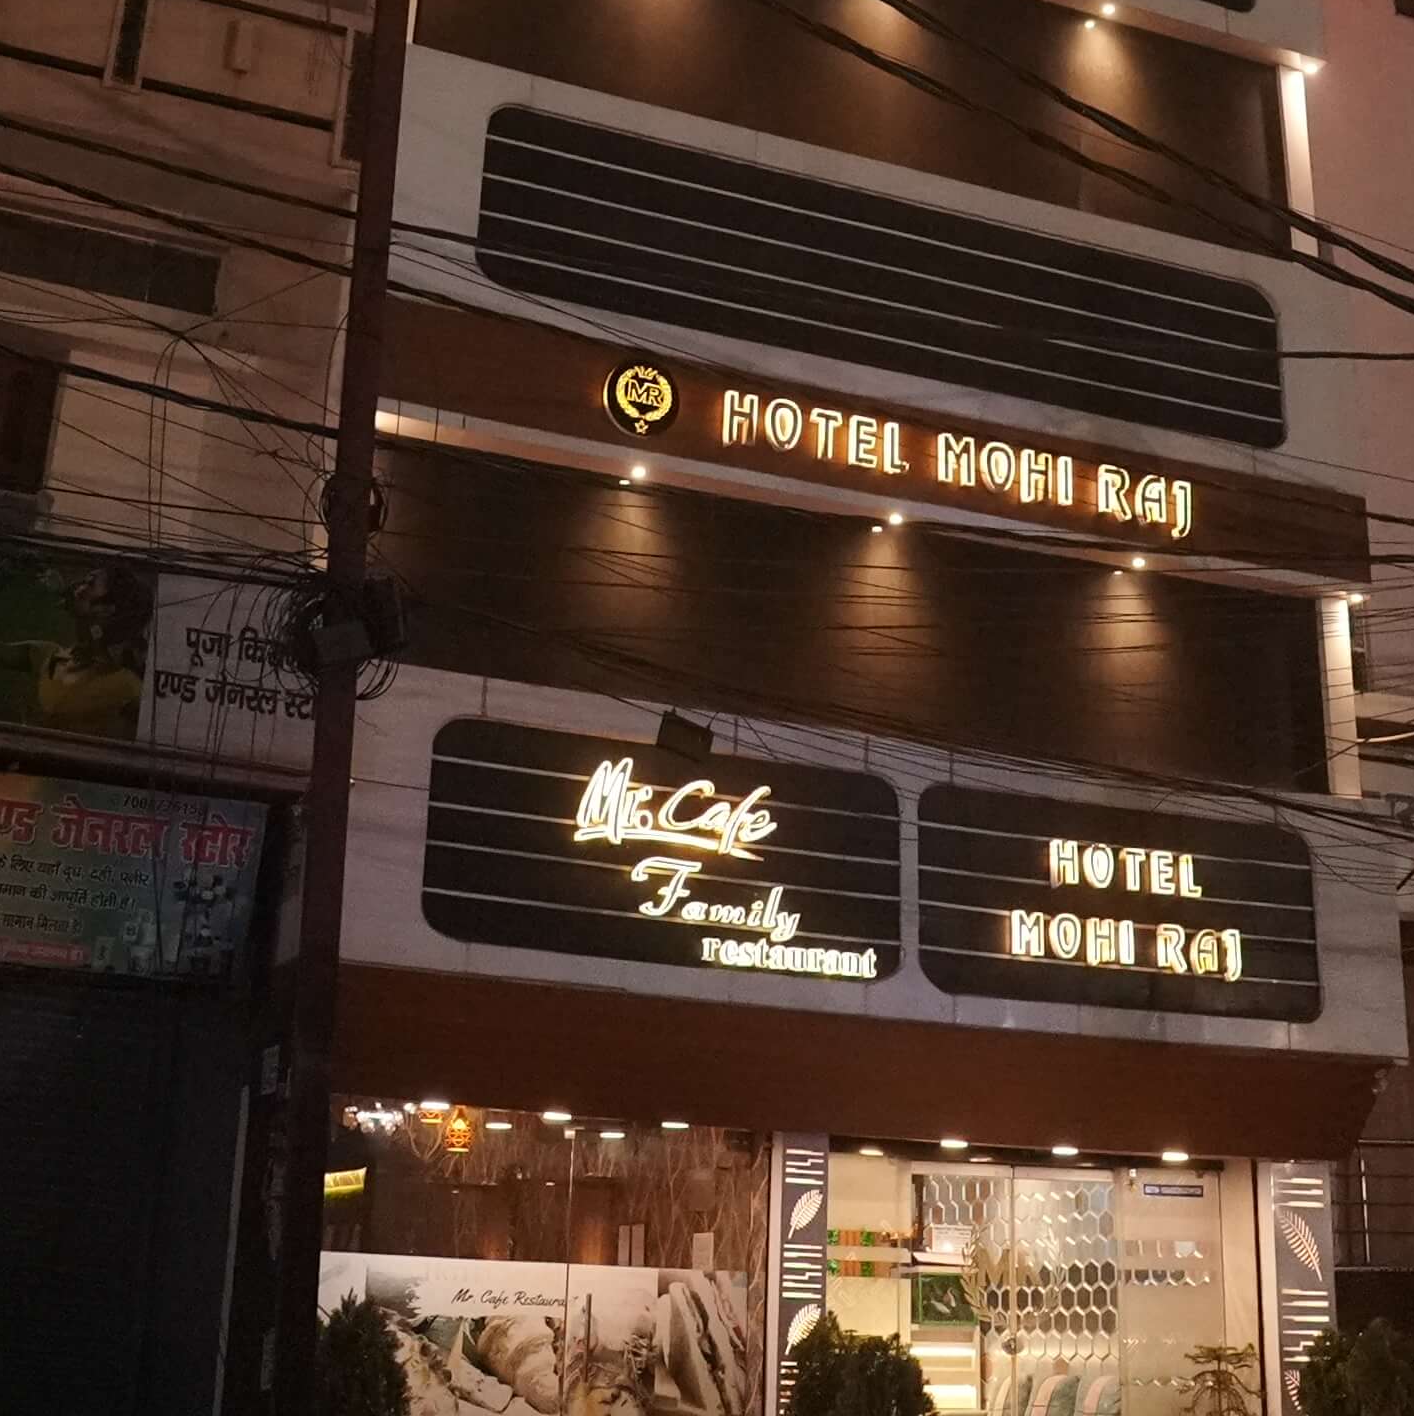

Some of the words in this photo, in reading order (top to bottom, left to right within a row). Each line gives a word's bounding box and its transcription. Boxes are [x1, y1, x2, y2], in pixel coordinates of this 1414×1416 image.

[624, 377, 665, 407] MR
[721, 389, 909, 474] HOTEL
[937, 433, 1073, 506] MOHI
[1097, 464, 1192, 538] RAJ
[186, 628, 234, 668] पूजा
[154, 670, 203, 703] एण्ड
[51, 792, 171, 858] जेनरल
[574, 758, 653, 842] Mr.
[657, 779, 777, 853] Cafe
[632, 856, 800, 940] Family
[1049, 839, 1202, 899] HOTEL
[702, 936, 877, 979] restaurant
[1011, 910, 1136, 967] MOHI
[1156, 924, 1243, 982] RAJ
[481, 1290, 508, 1307] Cafe
[513, 1290, 579, 1307] Restaura
